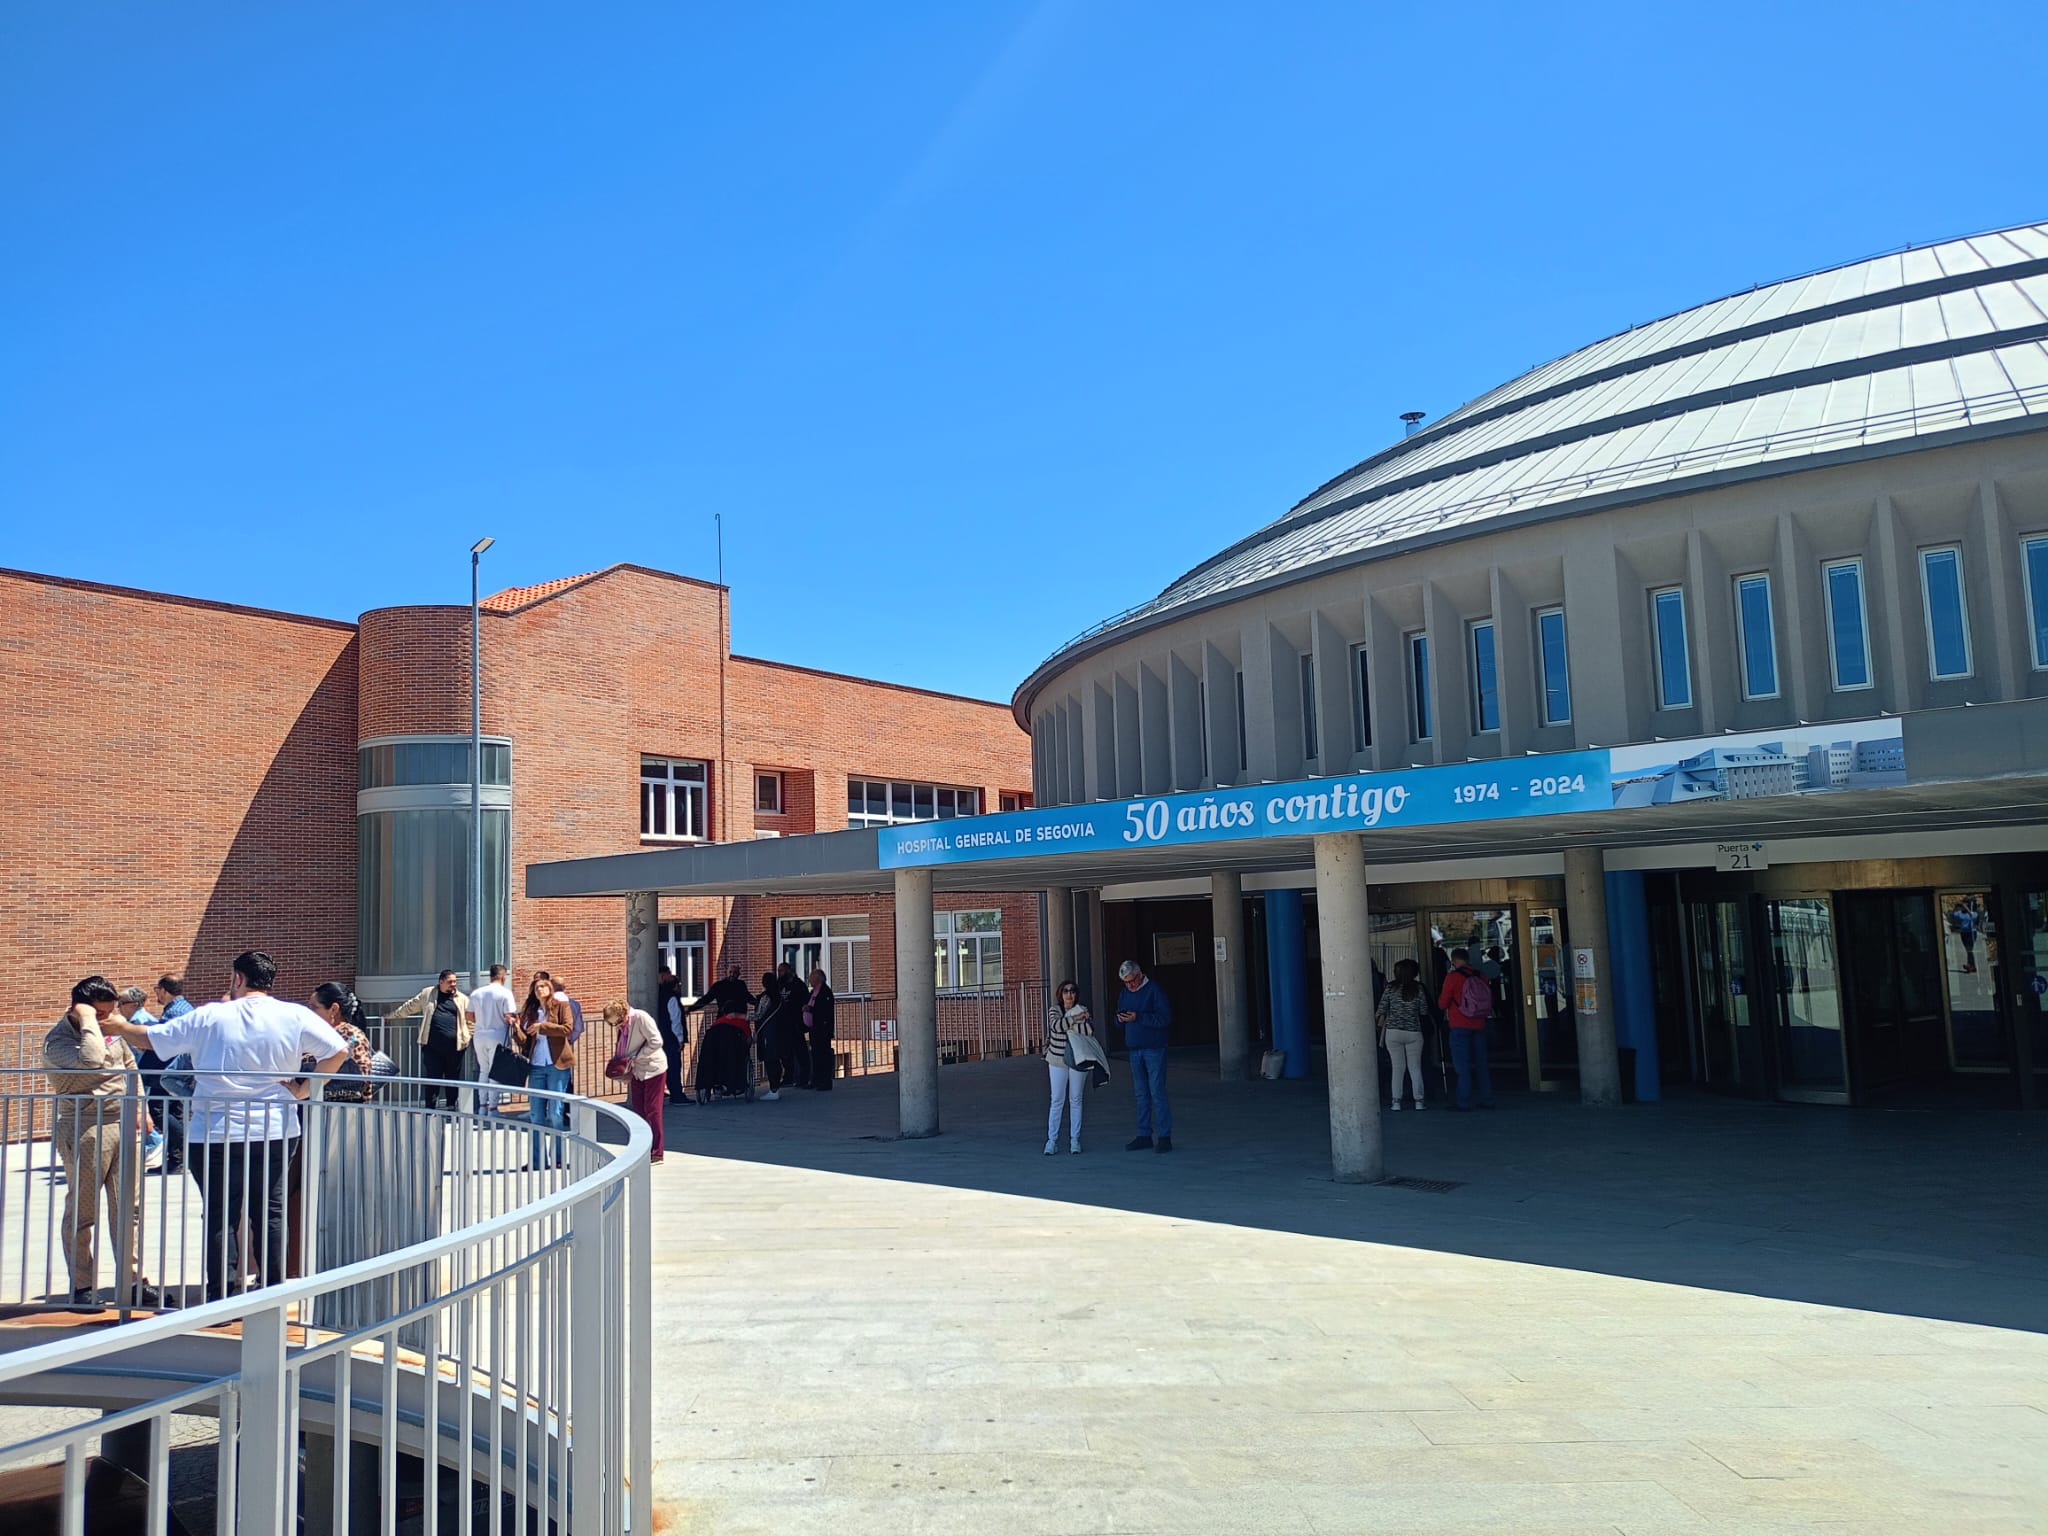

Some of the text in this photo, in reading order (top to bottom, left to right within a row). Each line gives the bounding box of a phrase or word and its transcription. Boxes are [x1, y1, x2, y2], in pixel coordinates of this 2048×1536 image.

[1454, 782, 1500, 804] 1974
[1529, 774, 1586, 797] 2024
[1123, 783, 1410, 842] 50 años contigo
[897, 822, 1095, 855] HOSPITAL GENERAL DE SEGOVIA
[1717, 844, 1749, 853] Puerta
[1730, 854, 1752, 868] 21
